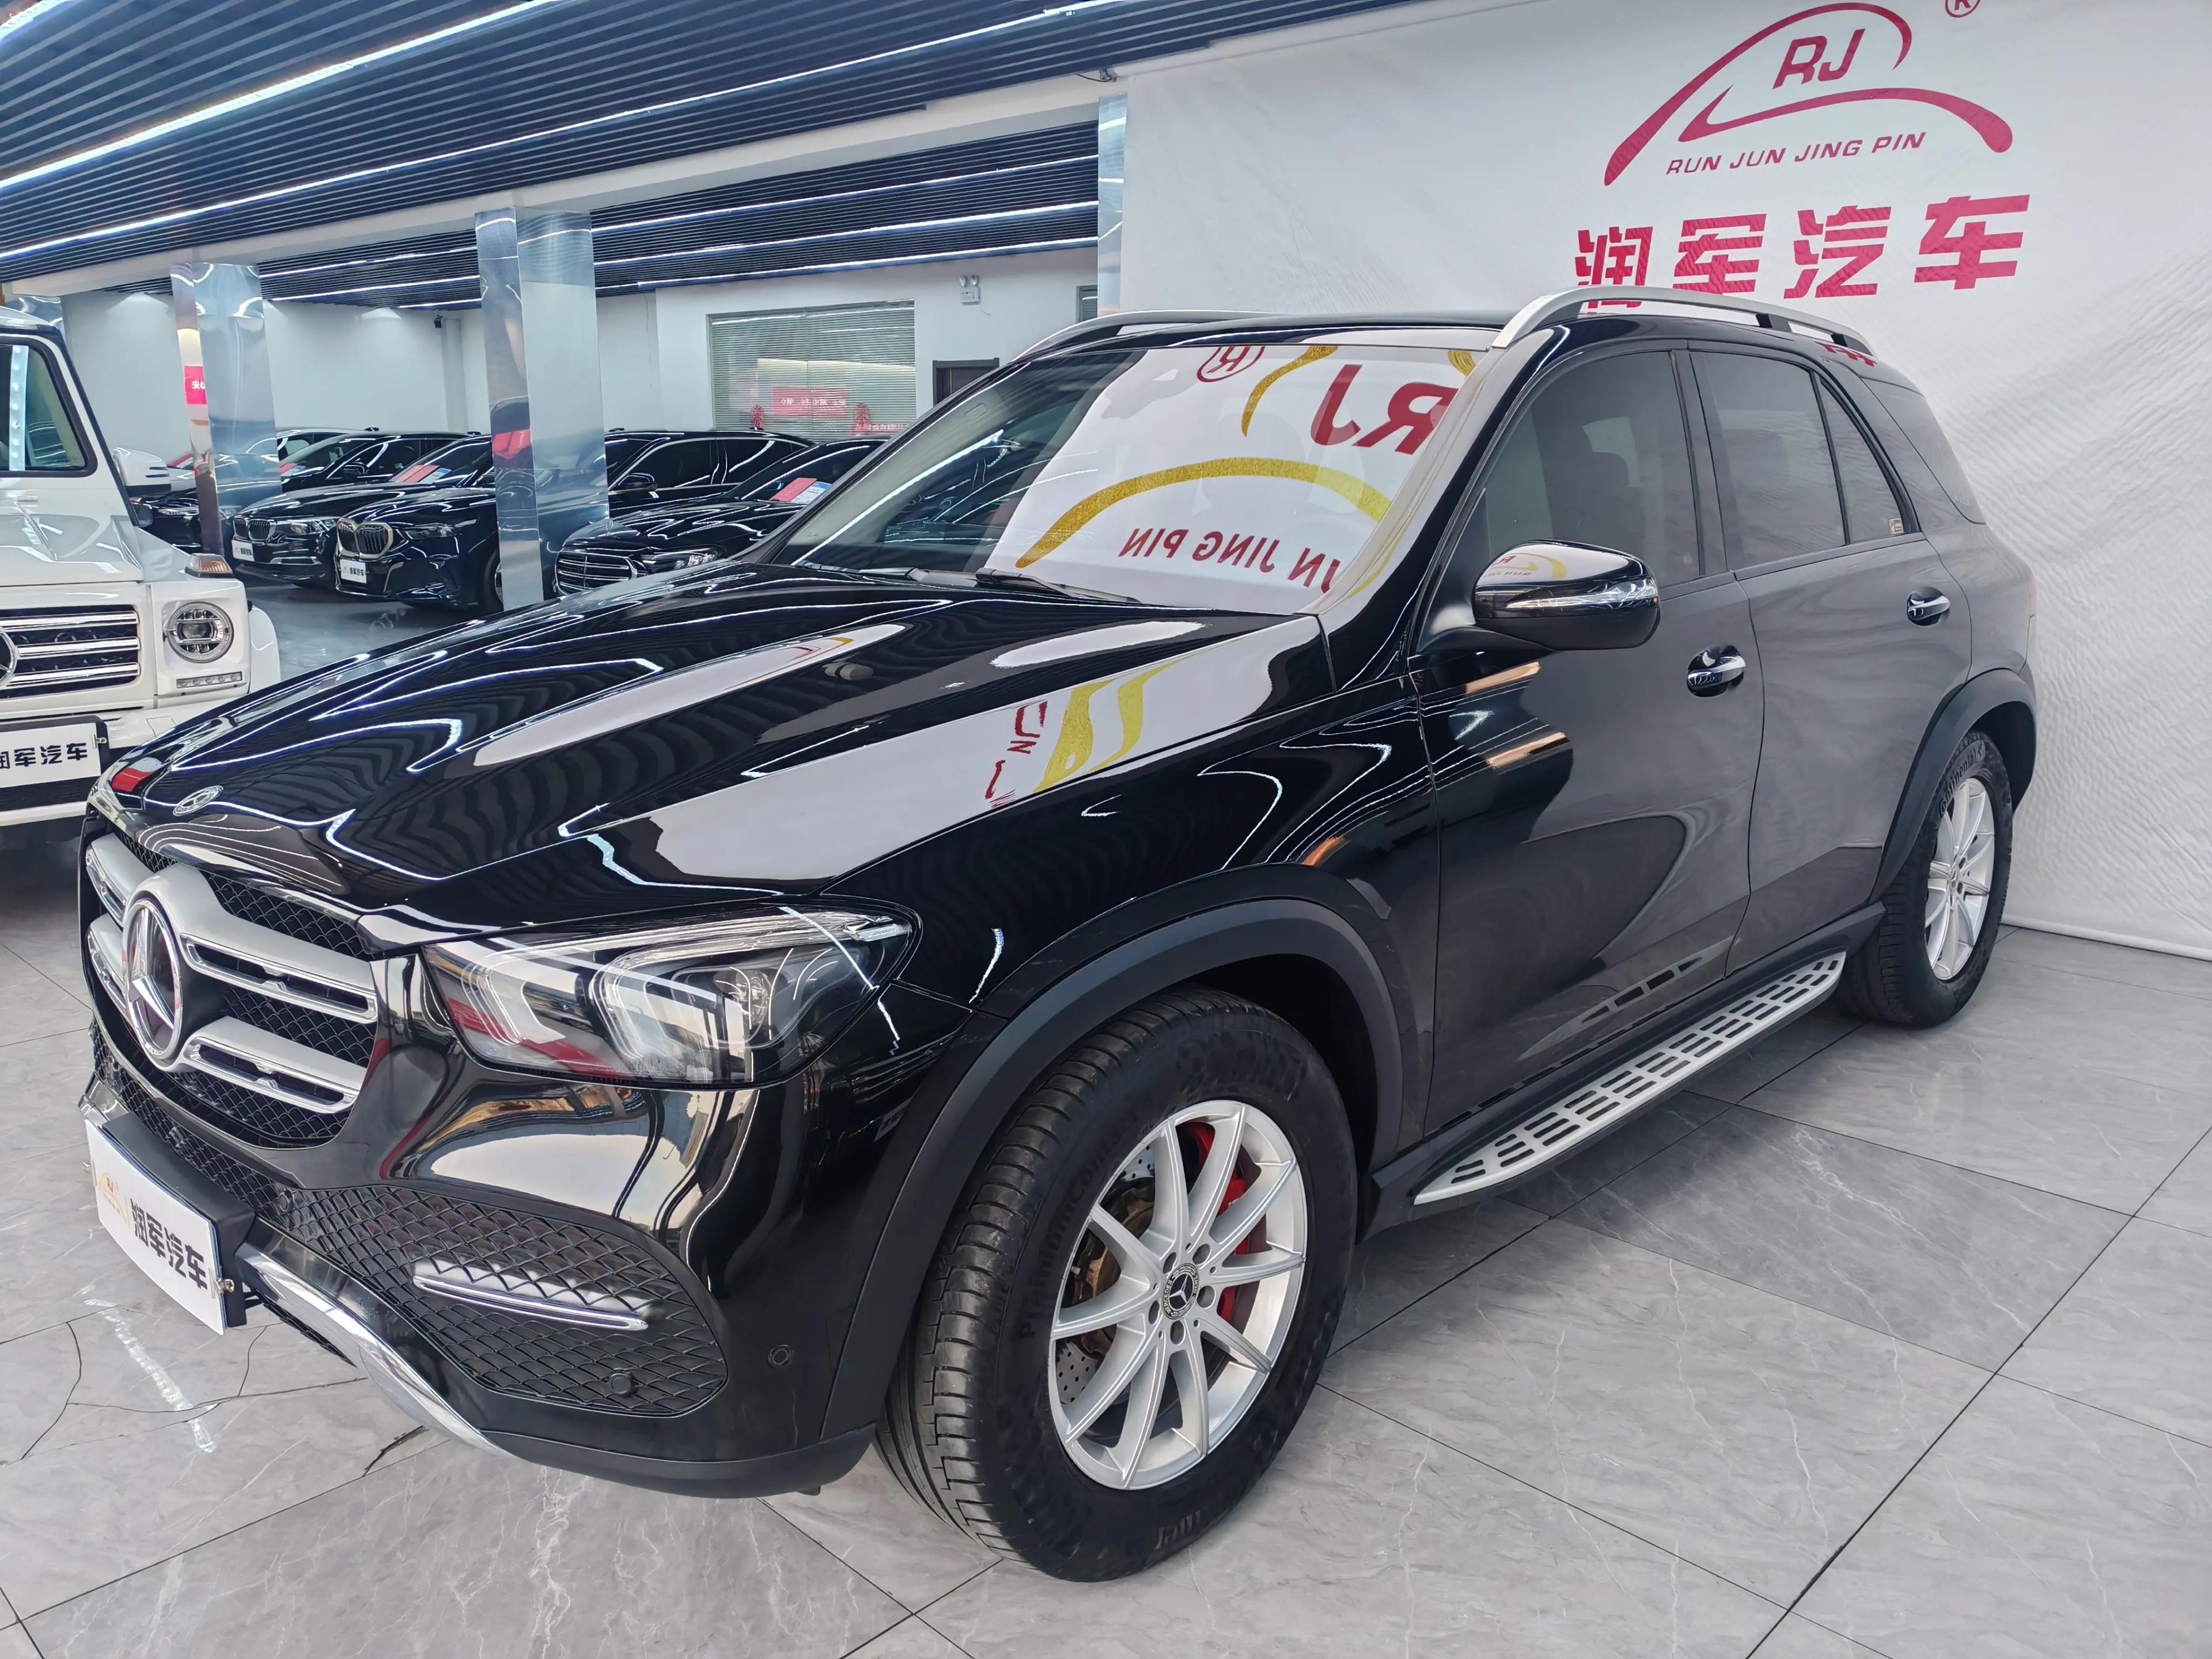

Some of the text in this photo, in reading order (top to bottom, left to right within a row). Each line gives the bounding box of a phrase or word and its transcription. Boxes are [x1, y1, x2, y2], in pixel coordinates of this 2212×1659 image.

[1772, 28, 1865, 89] RJ
[1666, 132, 1926, 175] RUN JUN JING PIN
[1574, 195, 2030, 309] 润军汽车
[130, 1198, 208, 1290] 润军汽车
[1164, 1279, 1173, 1315] MERCEDES
